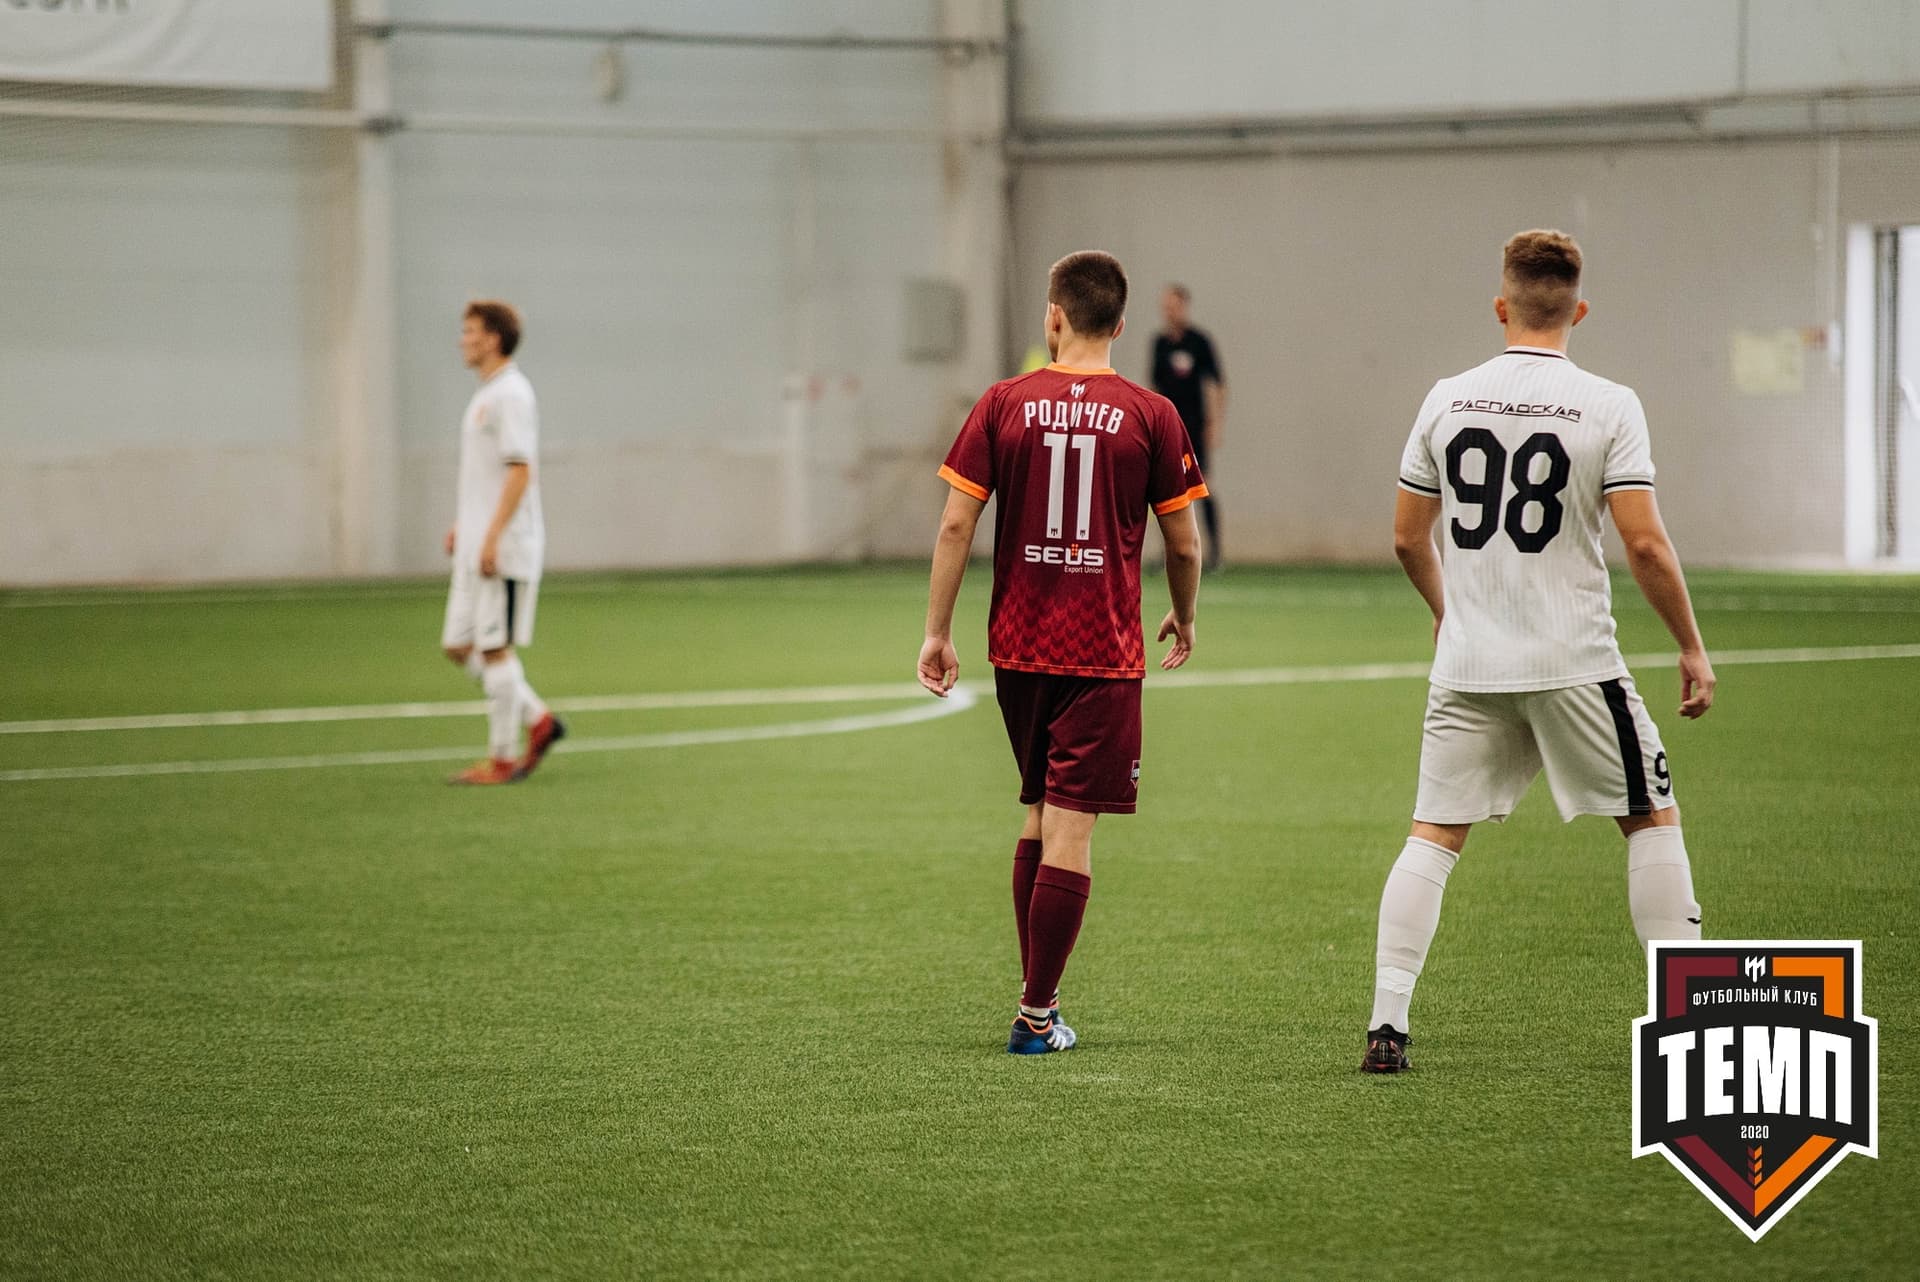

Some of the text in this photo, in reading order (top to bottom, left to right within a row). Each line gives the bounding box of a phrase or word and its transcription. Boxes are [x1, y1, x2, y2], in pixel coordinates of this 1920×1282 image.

[1024, 399, 1125, 435] РОДИЧЕВ
[1043, 431, 1097, 541] 11
[1445, 426, 1571, 554] 98
[1064, 566, 1104, 575] Export Union
